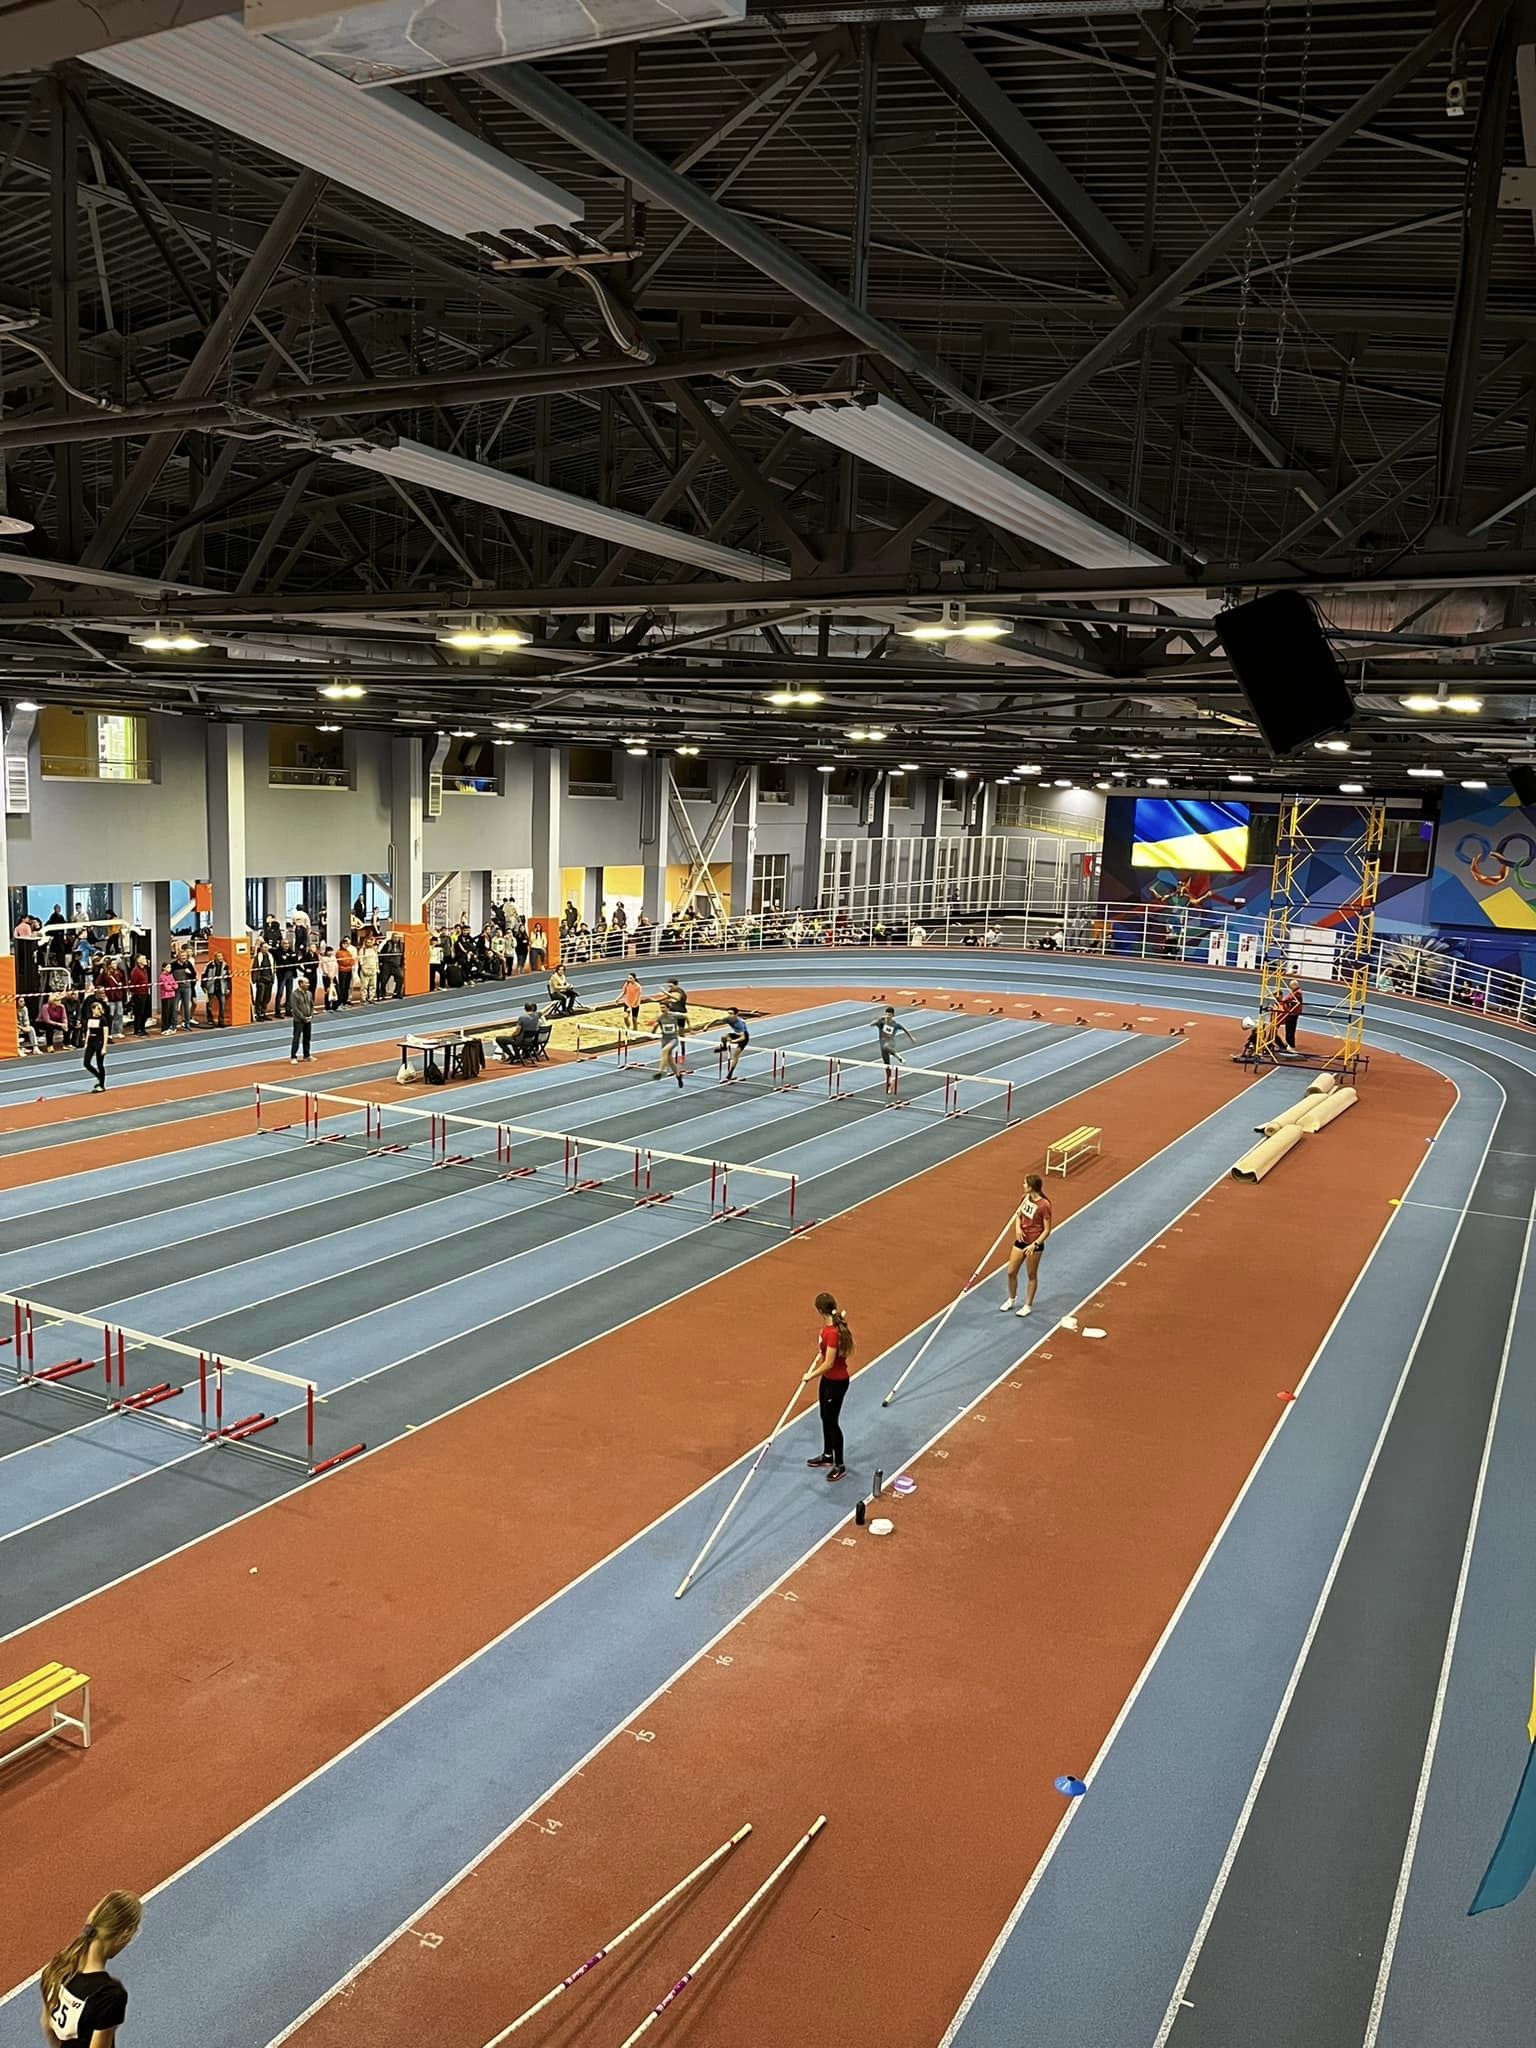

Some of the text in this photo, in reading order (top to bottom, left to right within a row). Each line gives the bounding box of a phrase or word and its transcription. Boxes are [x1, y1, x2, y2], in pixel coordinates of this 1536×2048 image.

[841, 1537, 857, 1548] 18
[783, 1591, 800, 1602] 17
[715, 1654, 734, 1666] 16
[635, 1729, 656, 1743] 15
[540, 1818, 563, 1836] 14
[419, 1931, 444, 1949] 13
